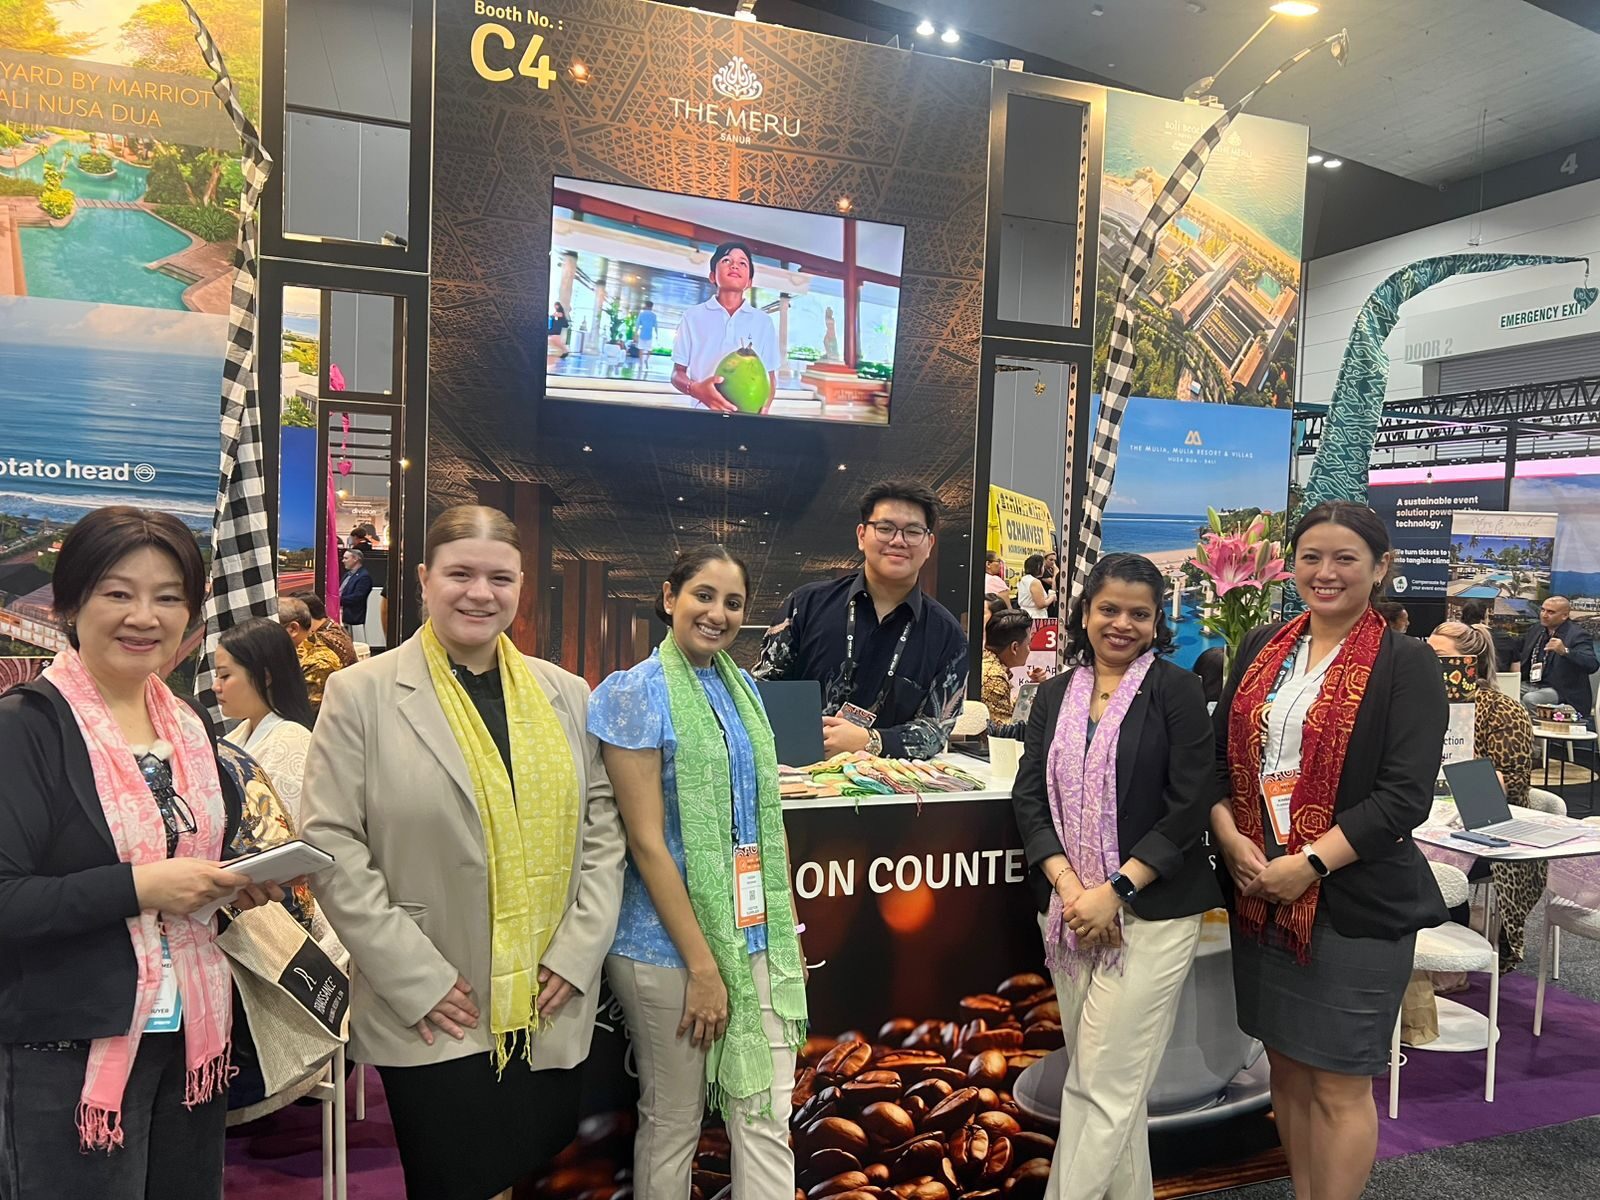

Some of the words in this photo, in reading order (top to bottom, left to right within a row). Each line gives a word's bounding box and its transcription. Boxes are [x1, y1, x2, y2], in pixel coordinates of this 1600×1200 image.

[474, 0, 522, 22] Booth
[527, 9, 554, 29] No.
[470, 22, 557, 90] C4
[0, 61, 63, 86] YARD
[72, 71, 100, 91] BY
[39, 94, 104, 119] NUSA
[112, 103, 162, 127] DUA
[669, 97, 719, 125] THE
[726, 106, 800, 137] MERU
[720, 133, 751, 145] SANUR
[1560, 152, 1578, 175] 4
[1501, 306, 1559, 328] EMERGENCY
[1405, 340, 1441, 361] DOOR
[1445, 337, 1453, 355] 2
[1130, 444, 1142, 452] THE
[1231, 451, 1253, 459] VILLAS
[0, 457, 61, 478] otato
[65, 459, 130, 481] head
[1396, 498, 1403, 506] A
[1404, 496, 1452, 506] sustainable
[1453, 495, 1479, 504] event
[1396, 508, 1429, 517] solution
[1006, 518, 1045, 546] OZHARVEST
[1395, 519, 1444, 530] technology.
[1419, 548, 1439, 556] tickets
[1045, 630, 1057, 649] 3
[795, 859, 855, 899] ON
[868, 848, 1025, 894] COUNTE
